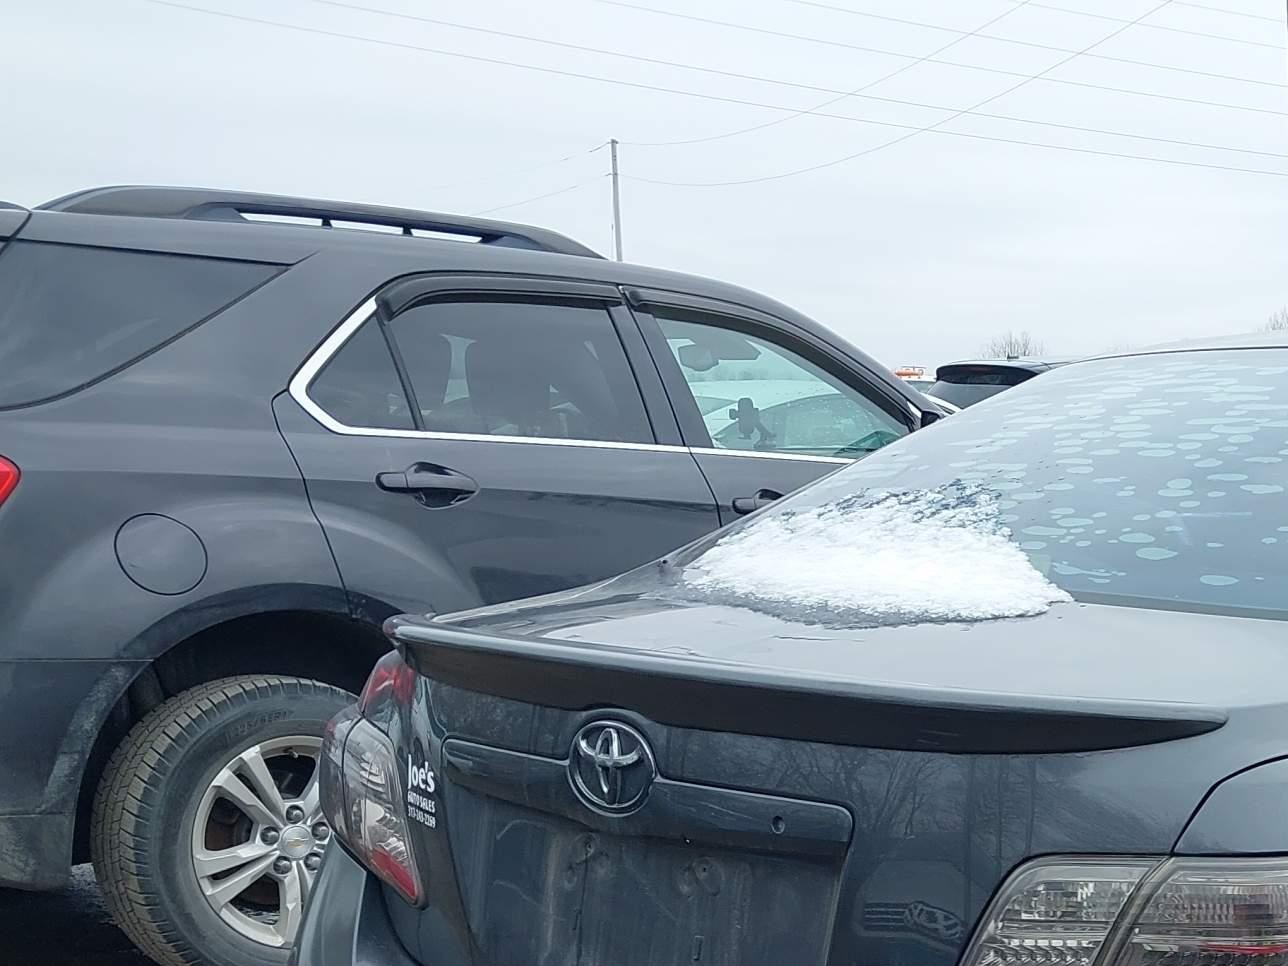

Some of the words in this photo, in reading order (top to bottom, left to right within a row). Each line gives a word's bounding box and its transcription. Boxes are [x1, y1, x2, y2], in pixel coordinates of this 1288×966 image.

[407, 753, 436, 793] Joe's
[407, 791, 420, 807] AUTO
[419, 796, 436, 814] SALES
